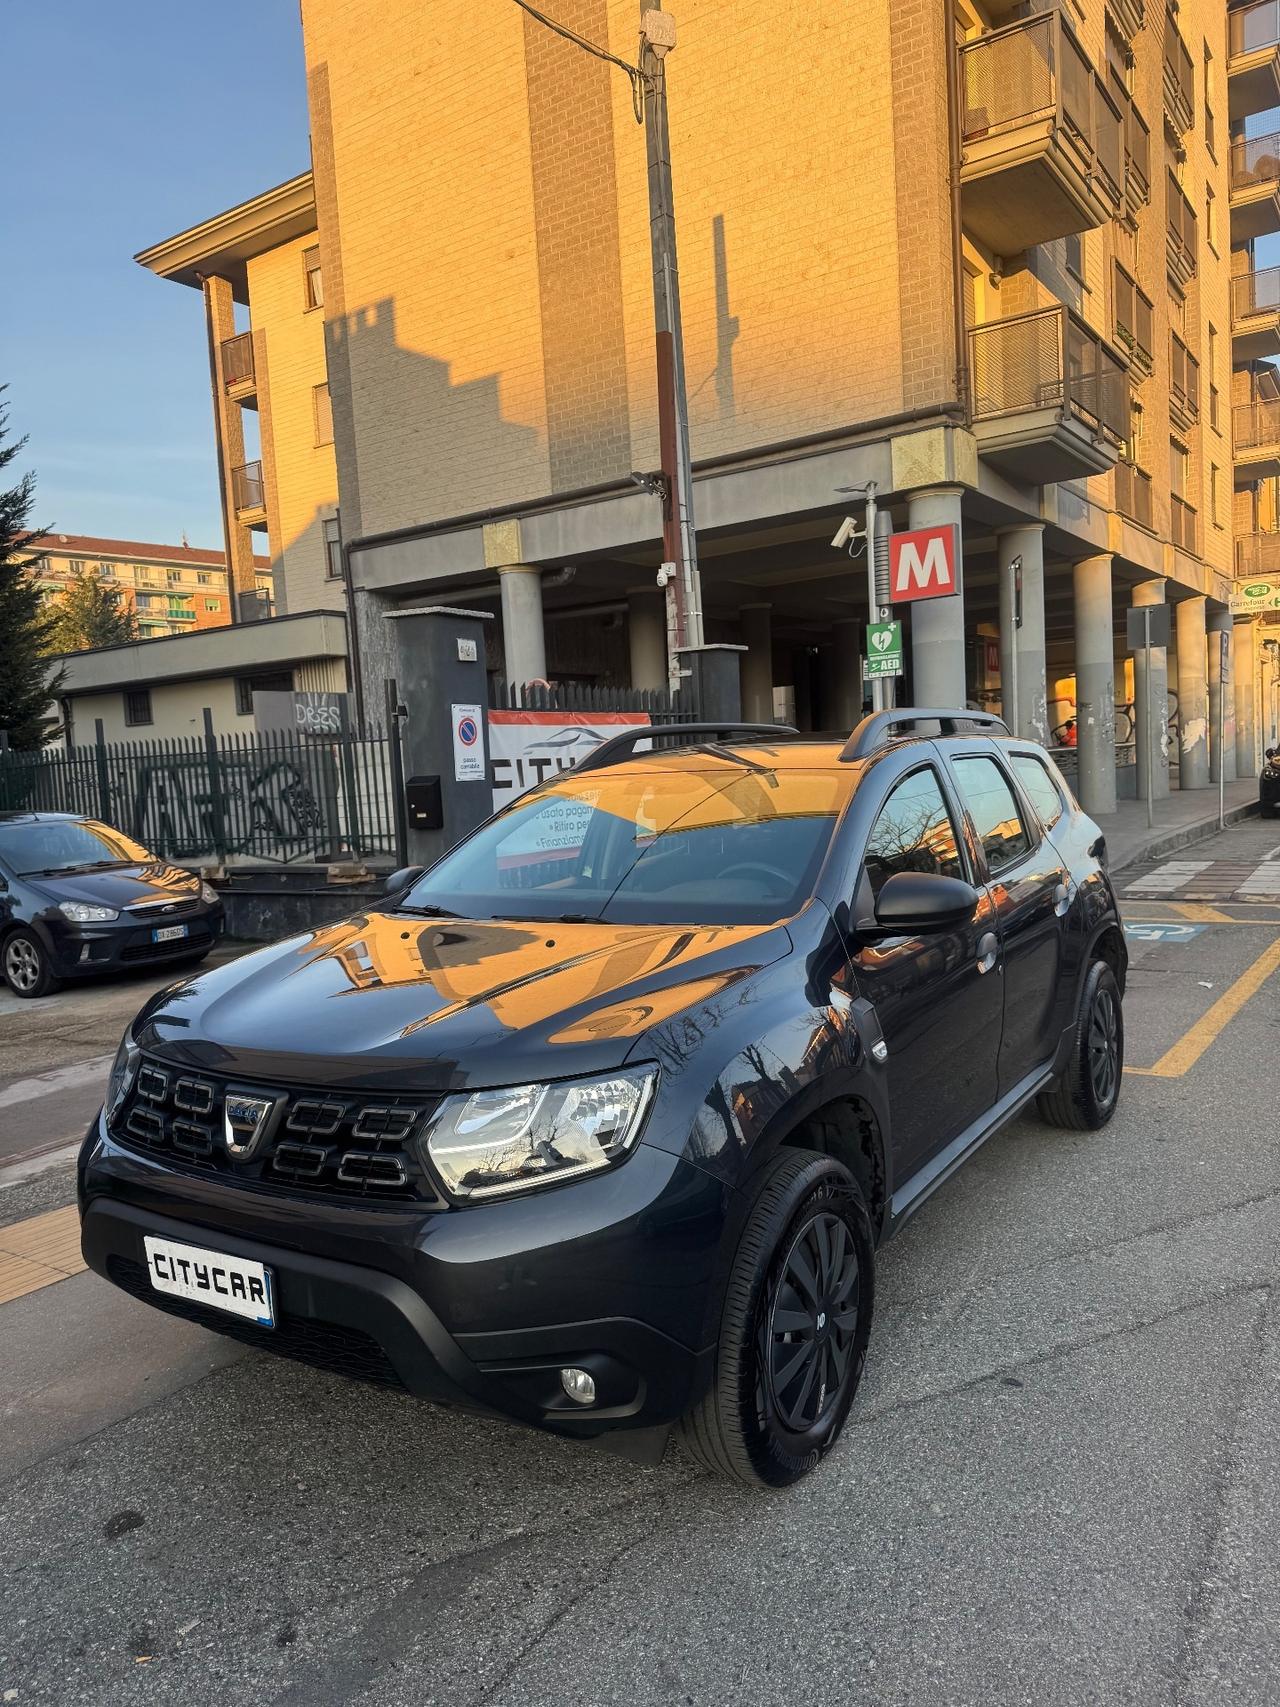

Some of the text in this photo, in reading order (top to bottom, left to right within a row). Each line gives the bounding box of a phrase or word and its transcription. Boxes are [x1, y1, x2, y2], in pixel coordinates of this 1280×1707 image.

[896, 537, 950, 592] M
[1230, 599, 1266, 608] Carrefour
[880, 659, 900, 670] AED
[541, 806, 564, 819] usato
[554, 821, 575, 833] Ritiro
[153, 1253, 266, 1305] CITYCAR
